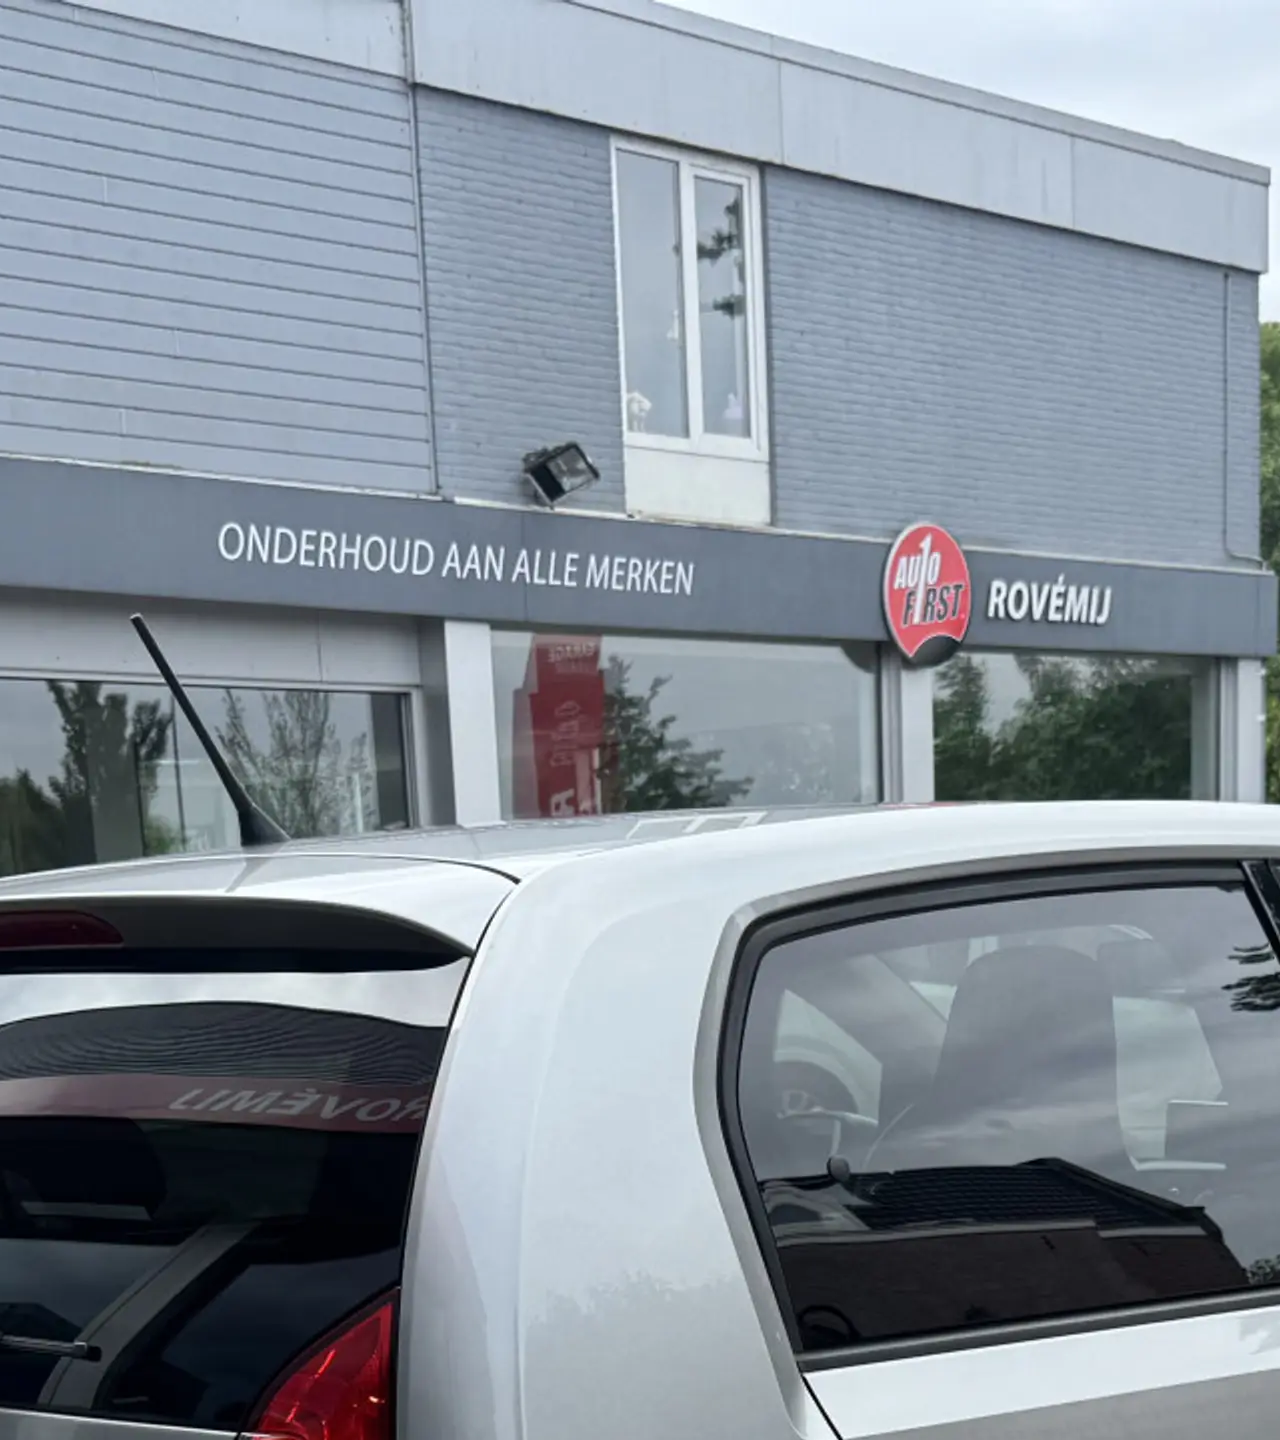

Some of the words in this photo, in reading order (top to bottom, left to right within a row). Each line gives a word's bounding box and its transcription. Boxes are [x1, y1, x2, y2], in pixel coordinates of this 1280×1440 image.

[217, 522, 435, 576] ONDERHOUD
[442, 543, 505, 582] AAN
[512, 549, 579, 587] ALLE
[585, 554, 695, 596] MERKEN
[987, 573, 1112, 625] ROVÉMIJ
